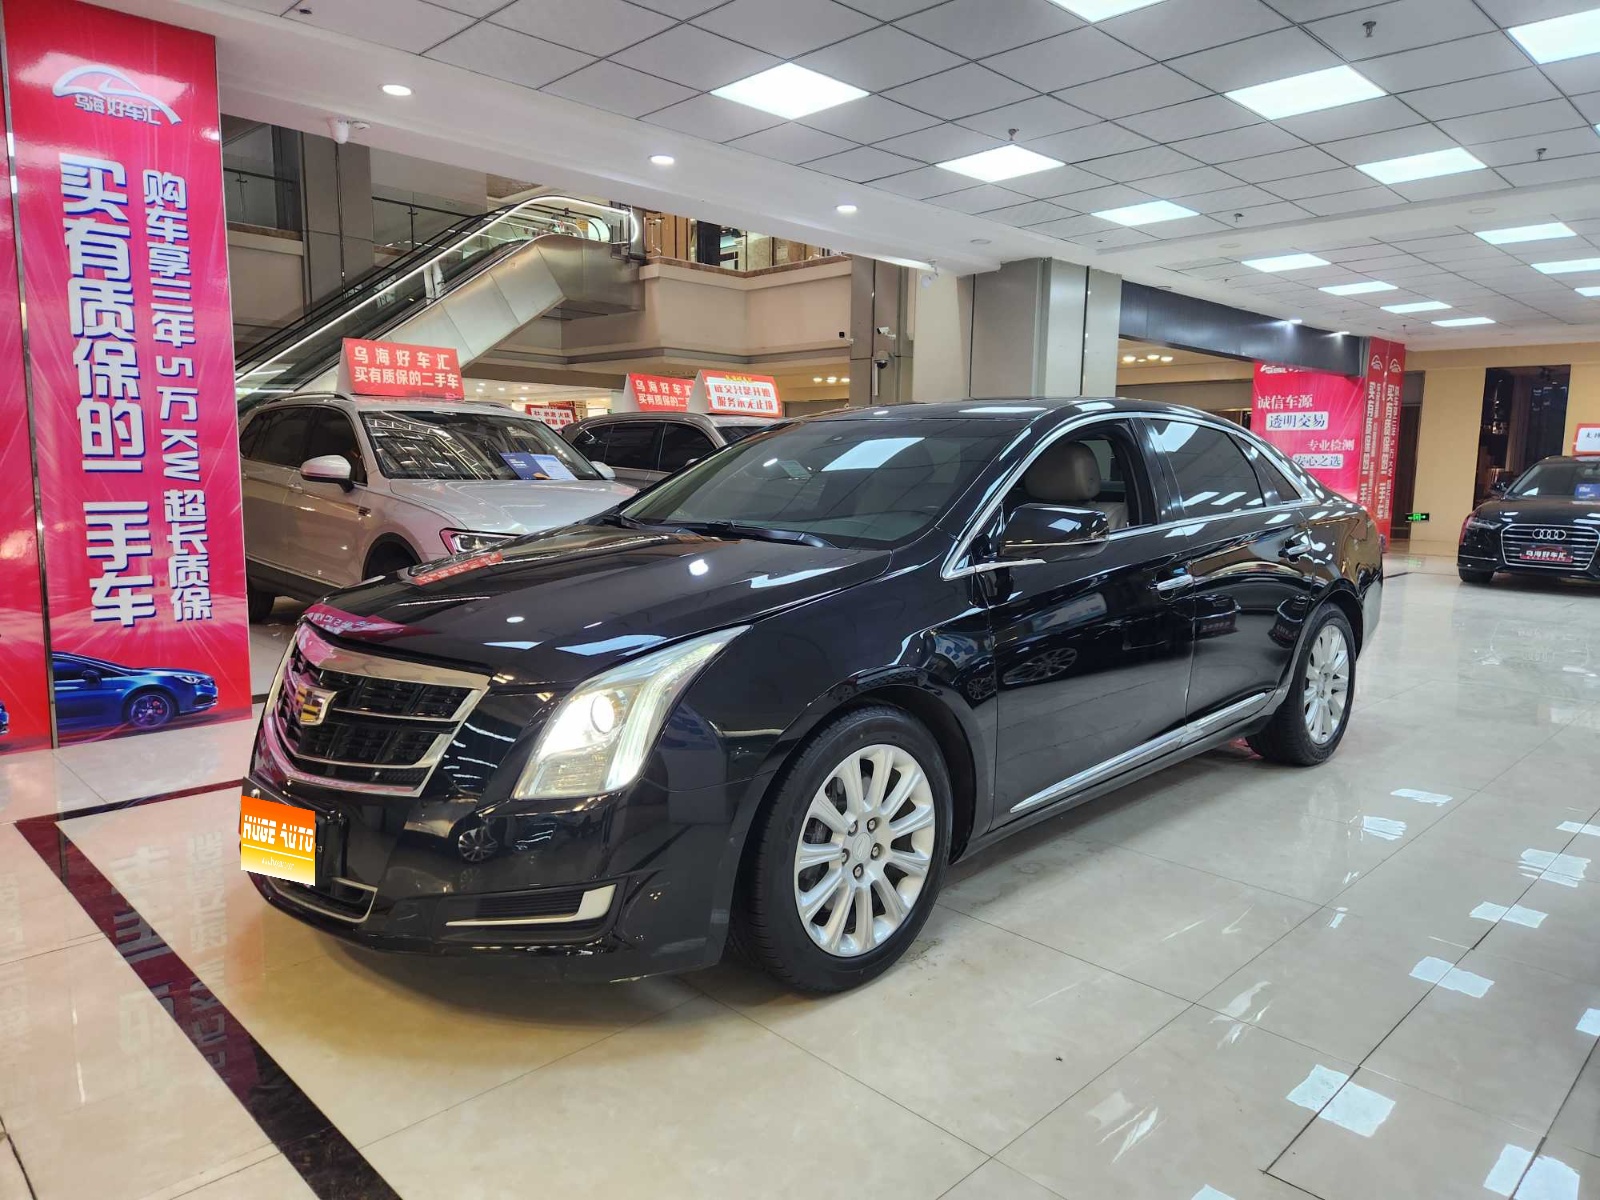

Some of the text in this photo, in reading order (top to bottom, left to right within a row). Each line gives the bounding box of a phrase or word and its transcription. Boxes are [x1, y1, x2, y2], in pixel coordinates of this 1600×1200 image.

[354, 346, 451, 371] 乌海好车汇
[354, 366, 459, 389] 买有质保的二手车
[59, 152, 156, 626] 买有质保的二手车
[1257, 394, 1313, 410] 诚信车源
[1269, 413, 1325, 429] 透明交易
[1307, 438, 1355, 451] 专业检测
